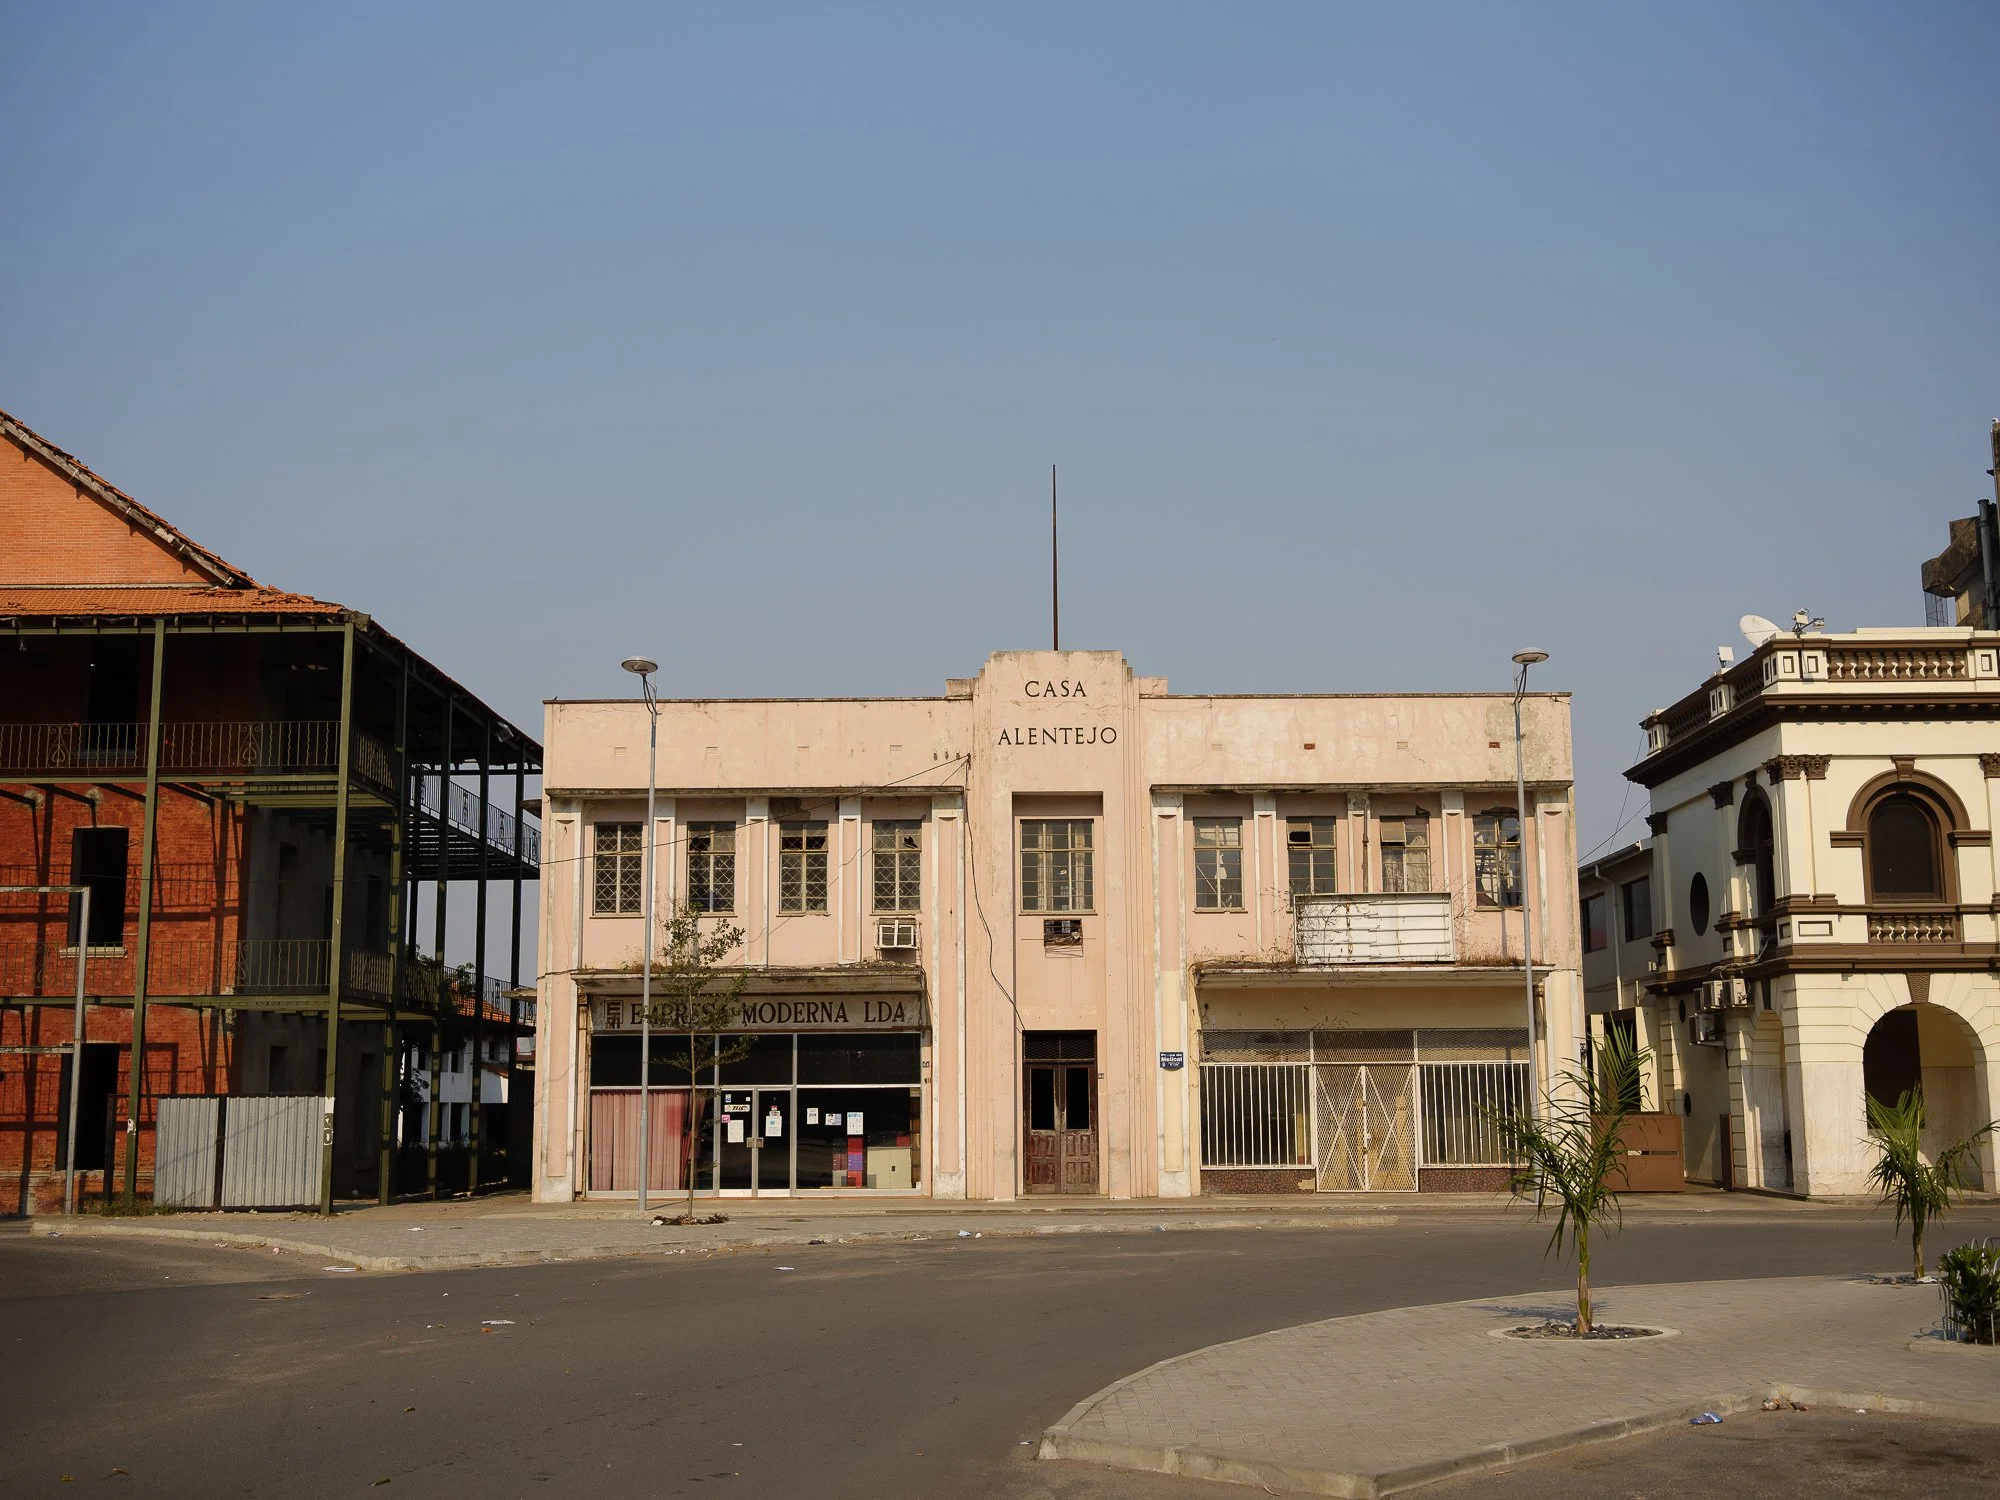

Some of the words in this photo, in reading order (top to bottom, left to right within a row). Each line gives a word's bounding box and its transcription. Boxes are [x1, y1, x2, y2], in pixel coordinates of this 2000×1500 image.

[1025, 680, 1087, 697] CASA
[997, 726, 1117, 745] ALENTEJO
[741, 1001, 848, 1023] MODERNA
